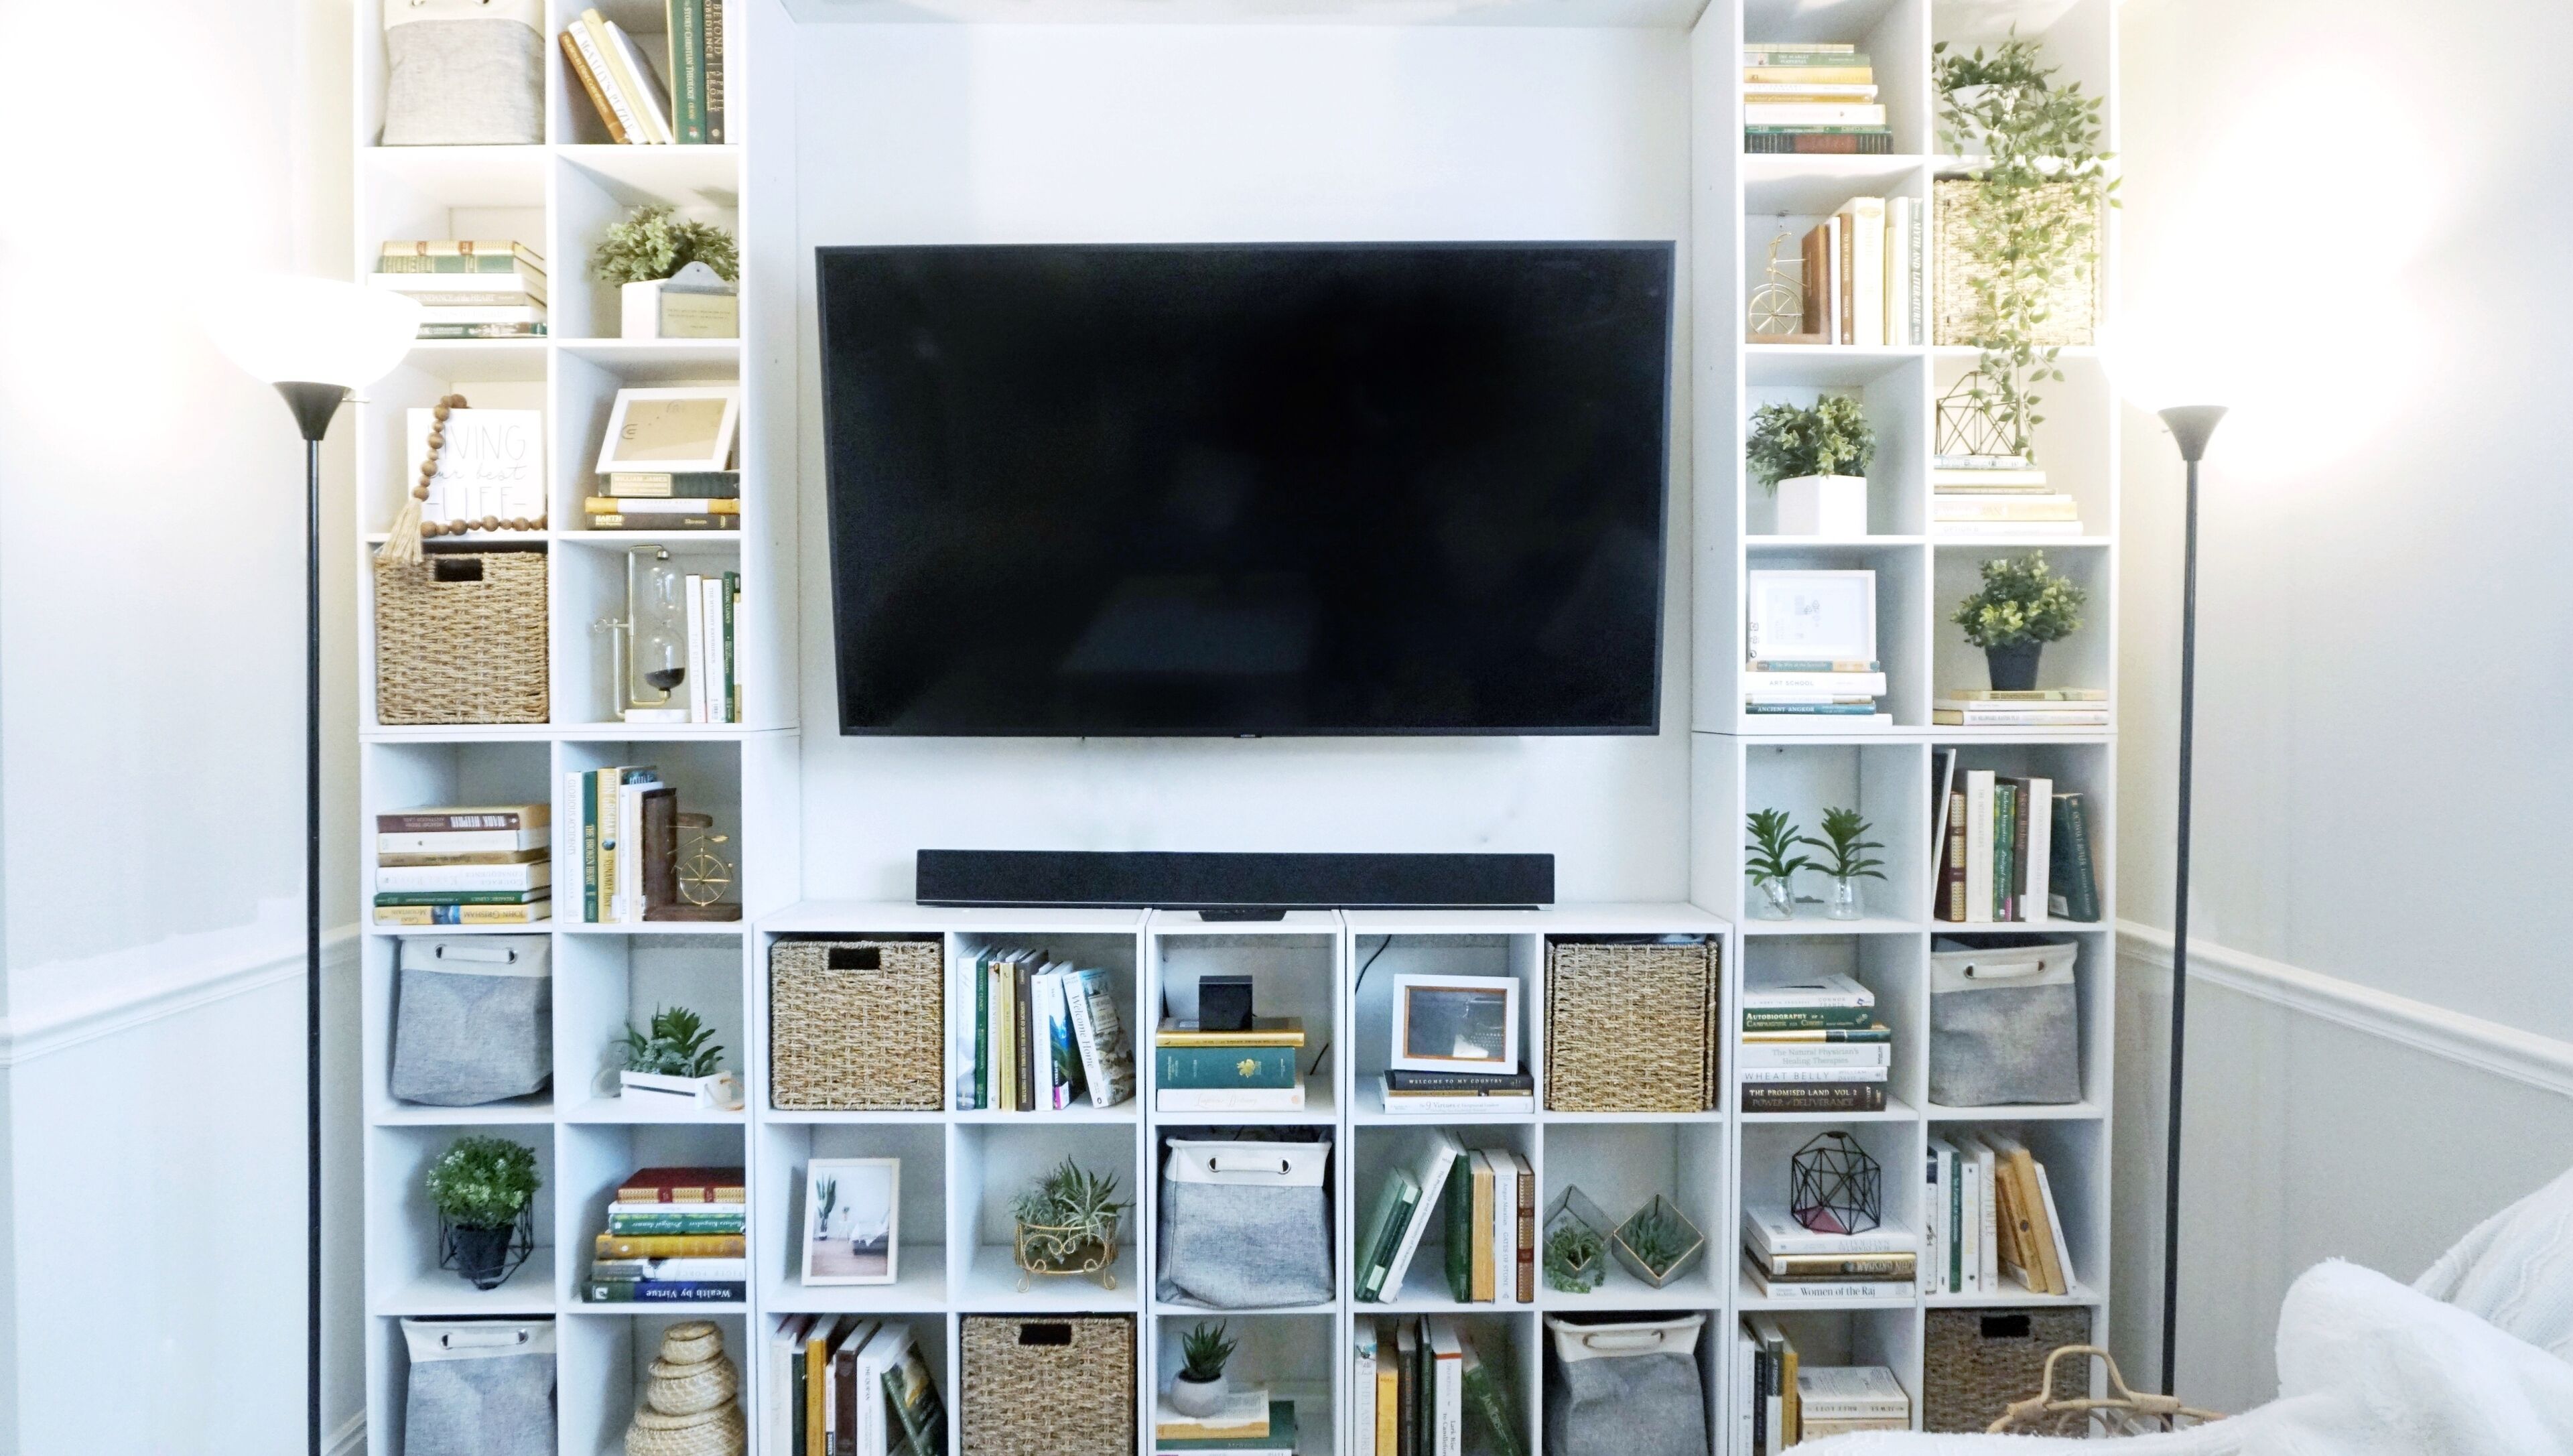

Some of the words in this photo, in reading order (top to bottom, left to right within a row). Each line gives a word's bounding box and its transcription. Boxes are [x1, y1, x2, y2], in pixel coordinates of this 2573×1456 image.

[705, 0, 714, 59] OBEDIENCE
[713, 3, 723, 56] BEYOND
[685, 31, 694, 66] CHRISTIAN
[686, 65, 696, 101] THEOLOGY
[715, 70, 724, 112] APRIL
[1912, 221, 1921, 248] MYTH
[1912, 249, 1921, 269] AND
[1912, 271, 1921, 325] LITERATURE
[476, 462, 528, 481] best
[603, 772, 616, 794] JOHN
[567, 779, 576, 816] GLORIOUS
[450, 816, 481, 828] HELPRIN
[482, 816, 507, 828] MARK
[603, 797, 616, 835] GRISHAM
[567, 818, 576, 856] ACCIDENTS
[585, 823, 595, 838] THE
[586, 838, 595, 865] BROKEN
[586, 866, 595, 886] HEART
[463, 911, 499, 920] GRISHAM
[499, 910, 526, 920] JOHN
[1071, 994, 1087, 1039] Welcome
[1081, 1039, 1094, 1069] Home
[1782, 1057, 1811, 1066] Healing
[1812, 1057, 1849, 1066] Therapies
[1788, 1048, 1817, 1056] Natural
[1819, 1048, 1859, 1057] Physician's
[1745, 1072, 1788, 1081] WHEAT
[1793, 1072, 1830, 1081] BELLY
[1750, 1089, 1766, 1097] THE
[1768, 1089, 1806, 1097] PROMISED
[1808, 1089, 1830, 1097] LAND
[1835, 1089, 1851, 1097] VOL
[1752, 1098, 1784, 1106] POWER
[1793, 1098, 1855, 1106] DELIVERANCE
[1503, 1254, 1509, 1262] OF
[645, 1288, 678, 1299] Virtue
[680, 1287, 694, 1299] by
[696, 1288, 732, 1299] Wealth
[1800, 1286, 1834, 1297] Women
[1835, 1286, 1845, 1297] of
[1845, 1286, 1860, 1297] the
[1861, 1286, 1875, 1298] Raj
